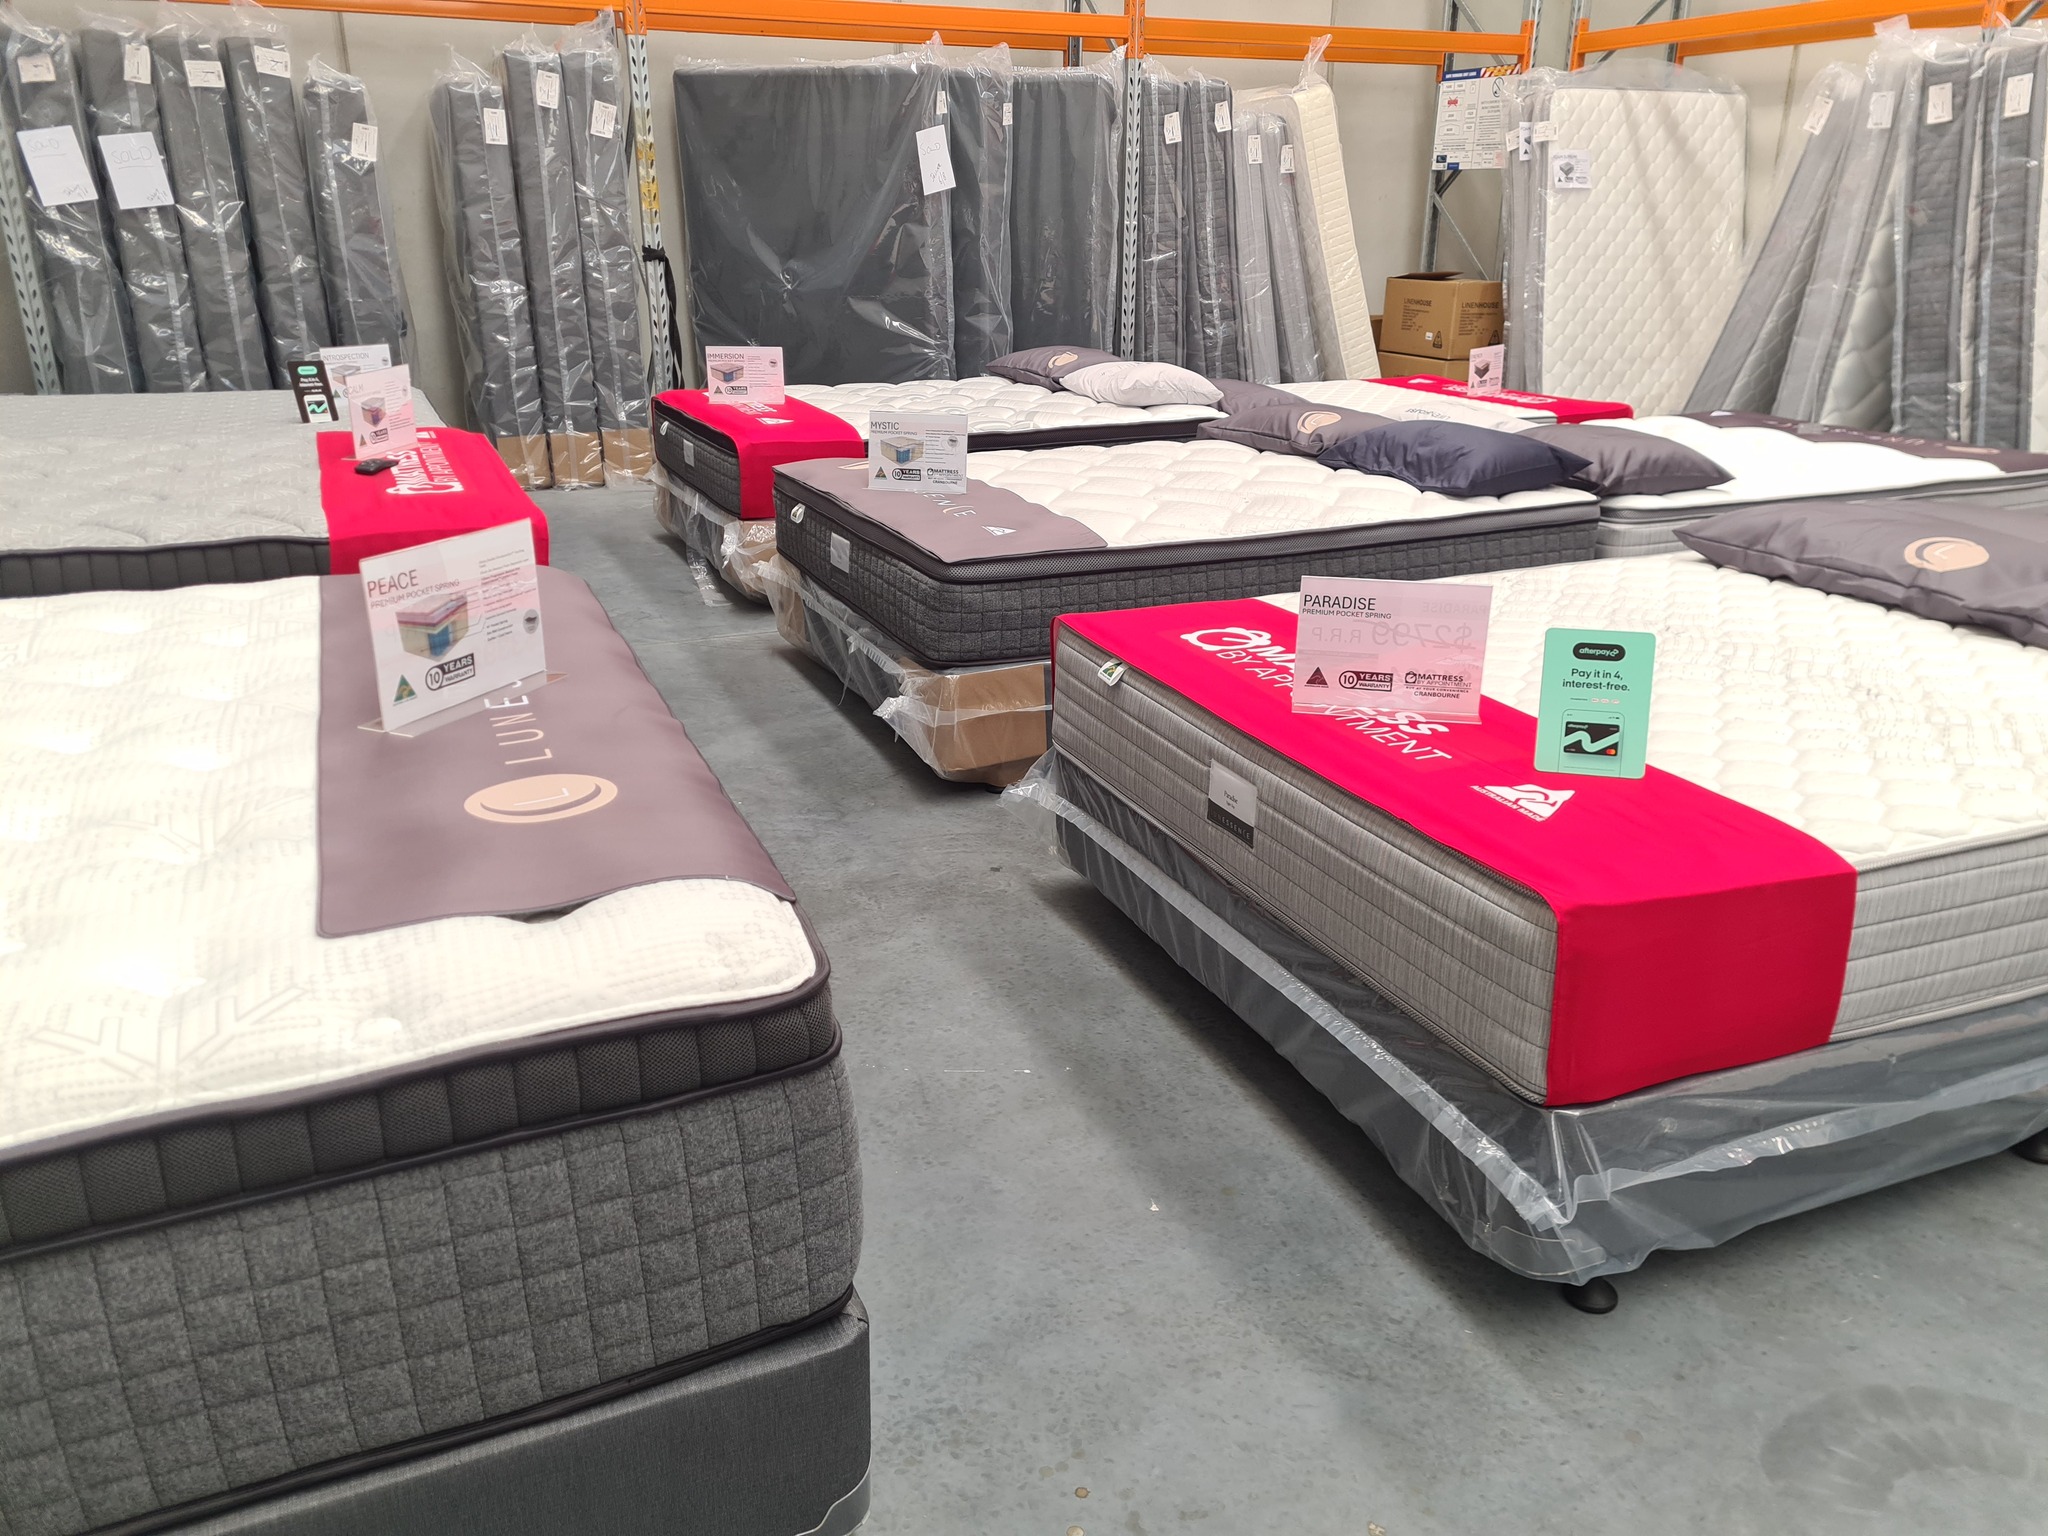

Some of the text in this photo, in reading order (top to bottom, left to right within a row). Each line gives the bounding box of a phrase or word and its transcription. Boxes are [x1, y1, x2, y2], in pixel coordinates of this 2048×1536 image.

[111, 146, 152, 164] SOLD
[322, 352, 370, 361] INTROSPECTION
[870, 421, 900, 431] MYSTIC
[367, 569, 419, 598] PEACE
[370, 579, 460, 609] PREMIUM POCKET SPRING
[1303, 594, 1376, 611] PARADISE
[1302, 608, 1392, 620] PREMIUM POCKET SPRING
[1216, 650, 1263, 664] BY
[1578, 647, 1611, 657] afterpay
[443, 656, 473, 672] YEARS
[429, 671, 440, 686] 10
[445, 668, 473, 682] WARRANTY
[1343, 674, 1355, 684] 10
[1359, 673, 1391, 682] YEARS
[1417, 673, 1464, 682] MATTRESS
[1571, 668, 1623, 681] Pay it in 4,
[1562, 679, 1630, 691] interest-free.
[1413, 691, 1460, 699] CRANBOURNE
